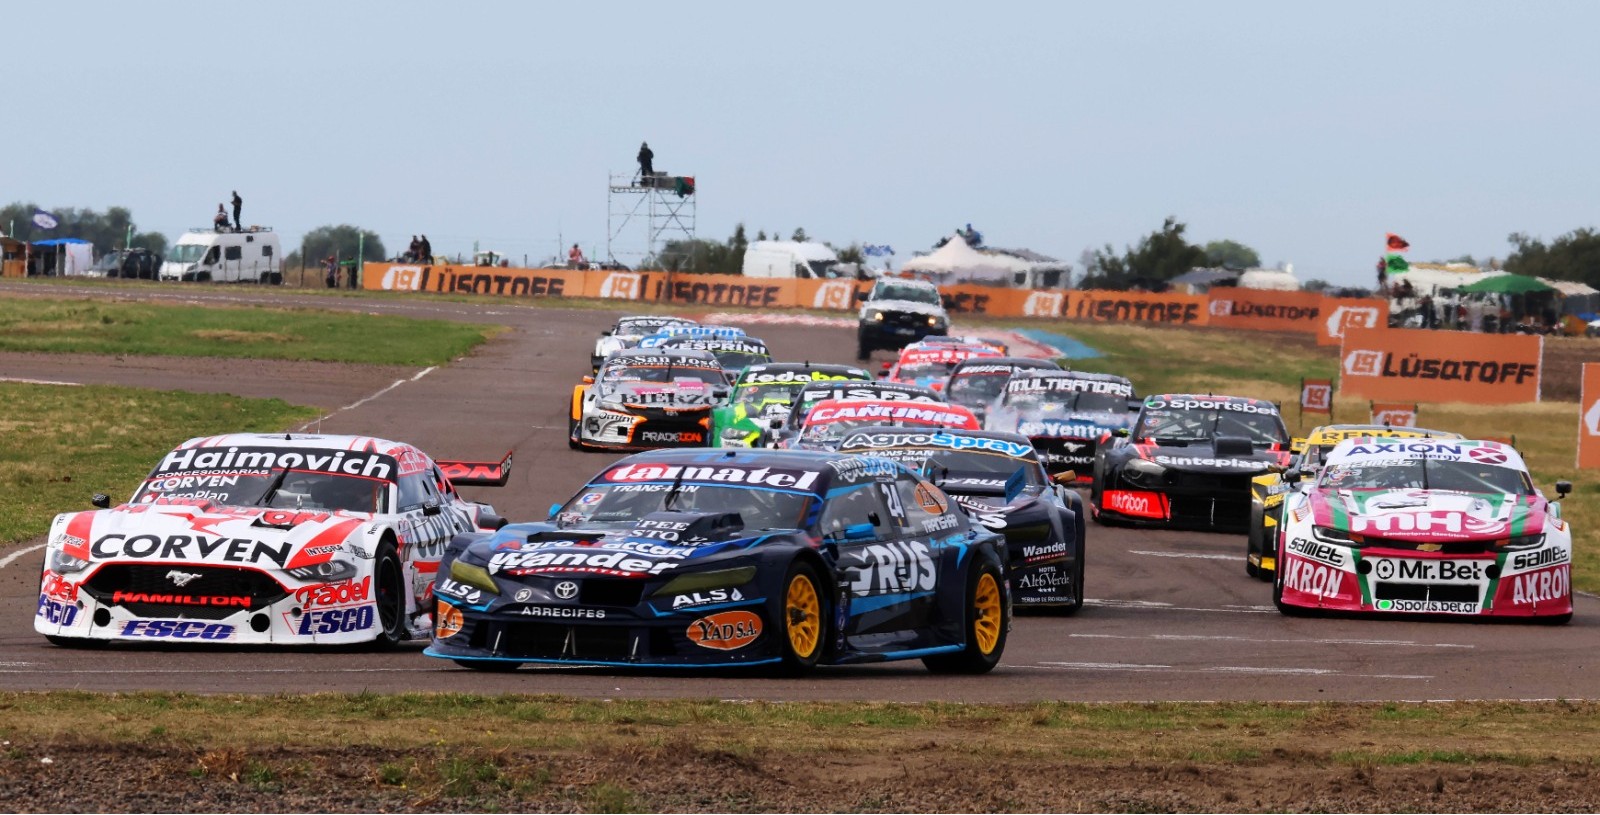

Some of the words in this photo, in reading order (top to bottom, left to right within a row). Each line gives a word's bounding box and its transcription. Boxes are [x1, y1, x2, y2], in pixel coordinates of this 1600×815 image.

[1007, 379, 1132, 397] MULTIBANDAS
[811, 404, 969, 425] CAÑUMIR
[1169, 400, 1278, 416] Sportsbet
[843, 434, 1033, 461] AgroSpray
[1346, 443, 1462, 458] AXION
[1409, 452, 1461, 461] energy
[156, 469, 269, 479] CONCESIONARIAS
[158, 447, 392, 480] Haimovich
[147, 475, 240, 492] CORVEN
[612, 464, 820, 490] tamatel
[91, 533, 293, 570] CORVEN
[305, 544, 344, 557] INTEGRA
[1023, 541, 1067, 558] Wander
[1288, 536, 1346, 564] samet
[1512, 546, 1569, 573] samet
[488, 552, 680, 576] Wander
[866, 540, 937, 594] RUS
[1283, 556, 1344, 600] AKRON
[1511, 567, 1571, 606] AKRON
[112, 590, 252, 609] HAMILTON
[295, 576, 371, 610] Fadel
[672, 588, 728, 608] ALS
[298, 605, 374, 636] ESCO
[521, 606, 606, 619] ARRECIFES
[121, 620, 235, 640] ESCO
[698, 620, 734, 641] YAD
